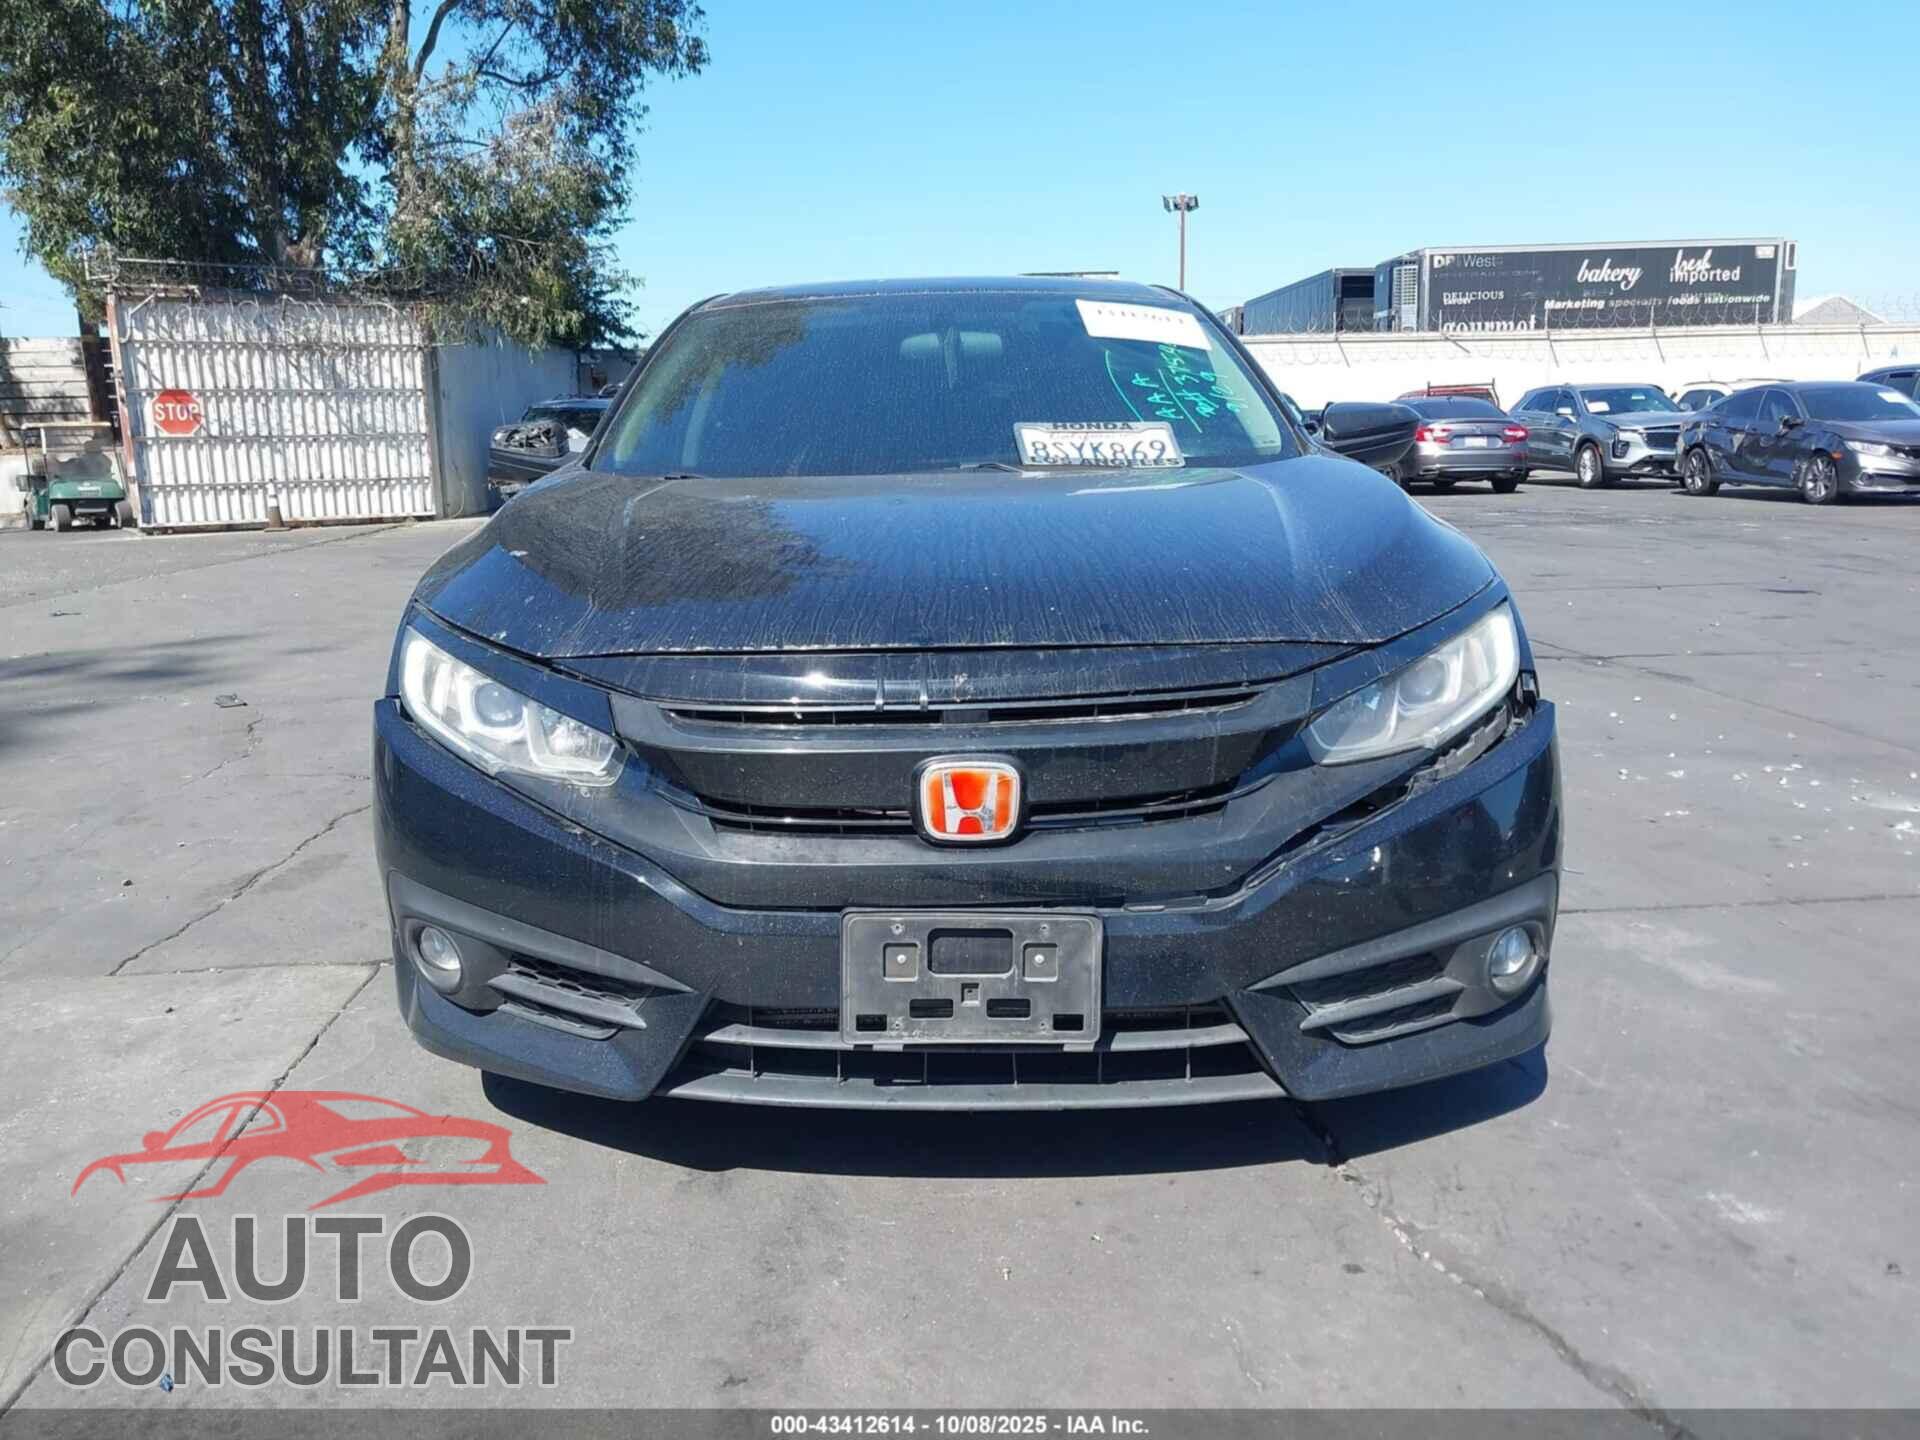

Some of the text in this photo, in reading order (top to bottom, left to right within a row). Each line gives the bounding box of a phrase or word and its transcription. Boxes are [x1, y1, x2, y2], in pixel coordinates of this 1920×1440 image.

[1463, 255, 1497, 268] West
[1577, 258, 1643, 291] bakery
[1670, 266, 1741, 285] imported
[1442, 290, 1505, 303] DELICIOUS
[154, 403, 199, 421] STOP
[1052, 422, 1134, 431] HONDA
[1031, 440, 1167, 464] 8SYK869
